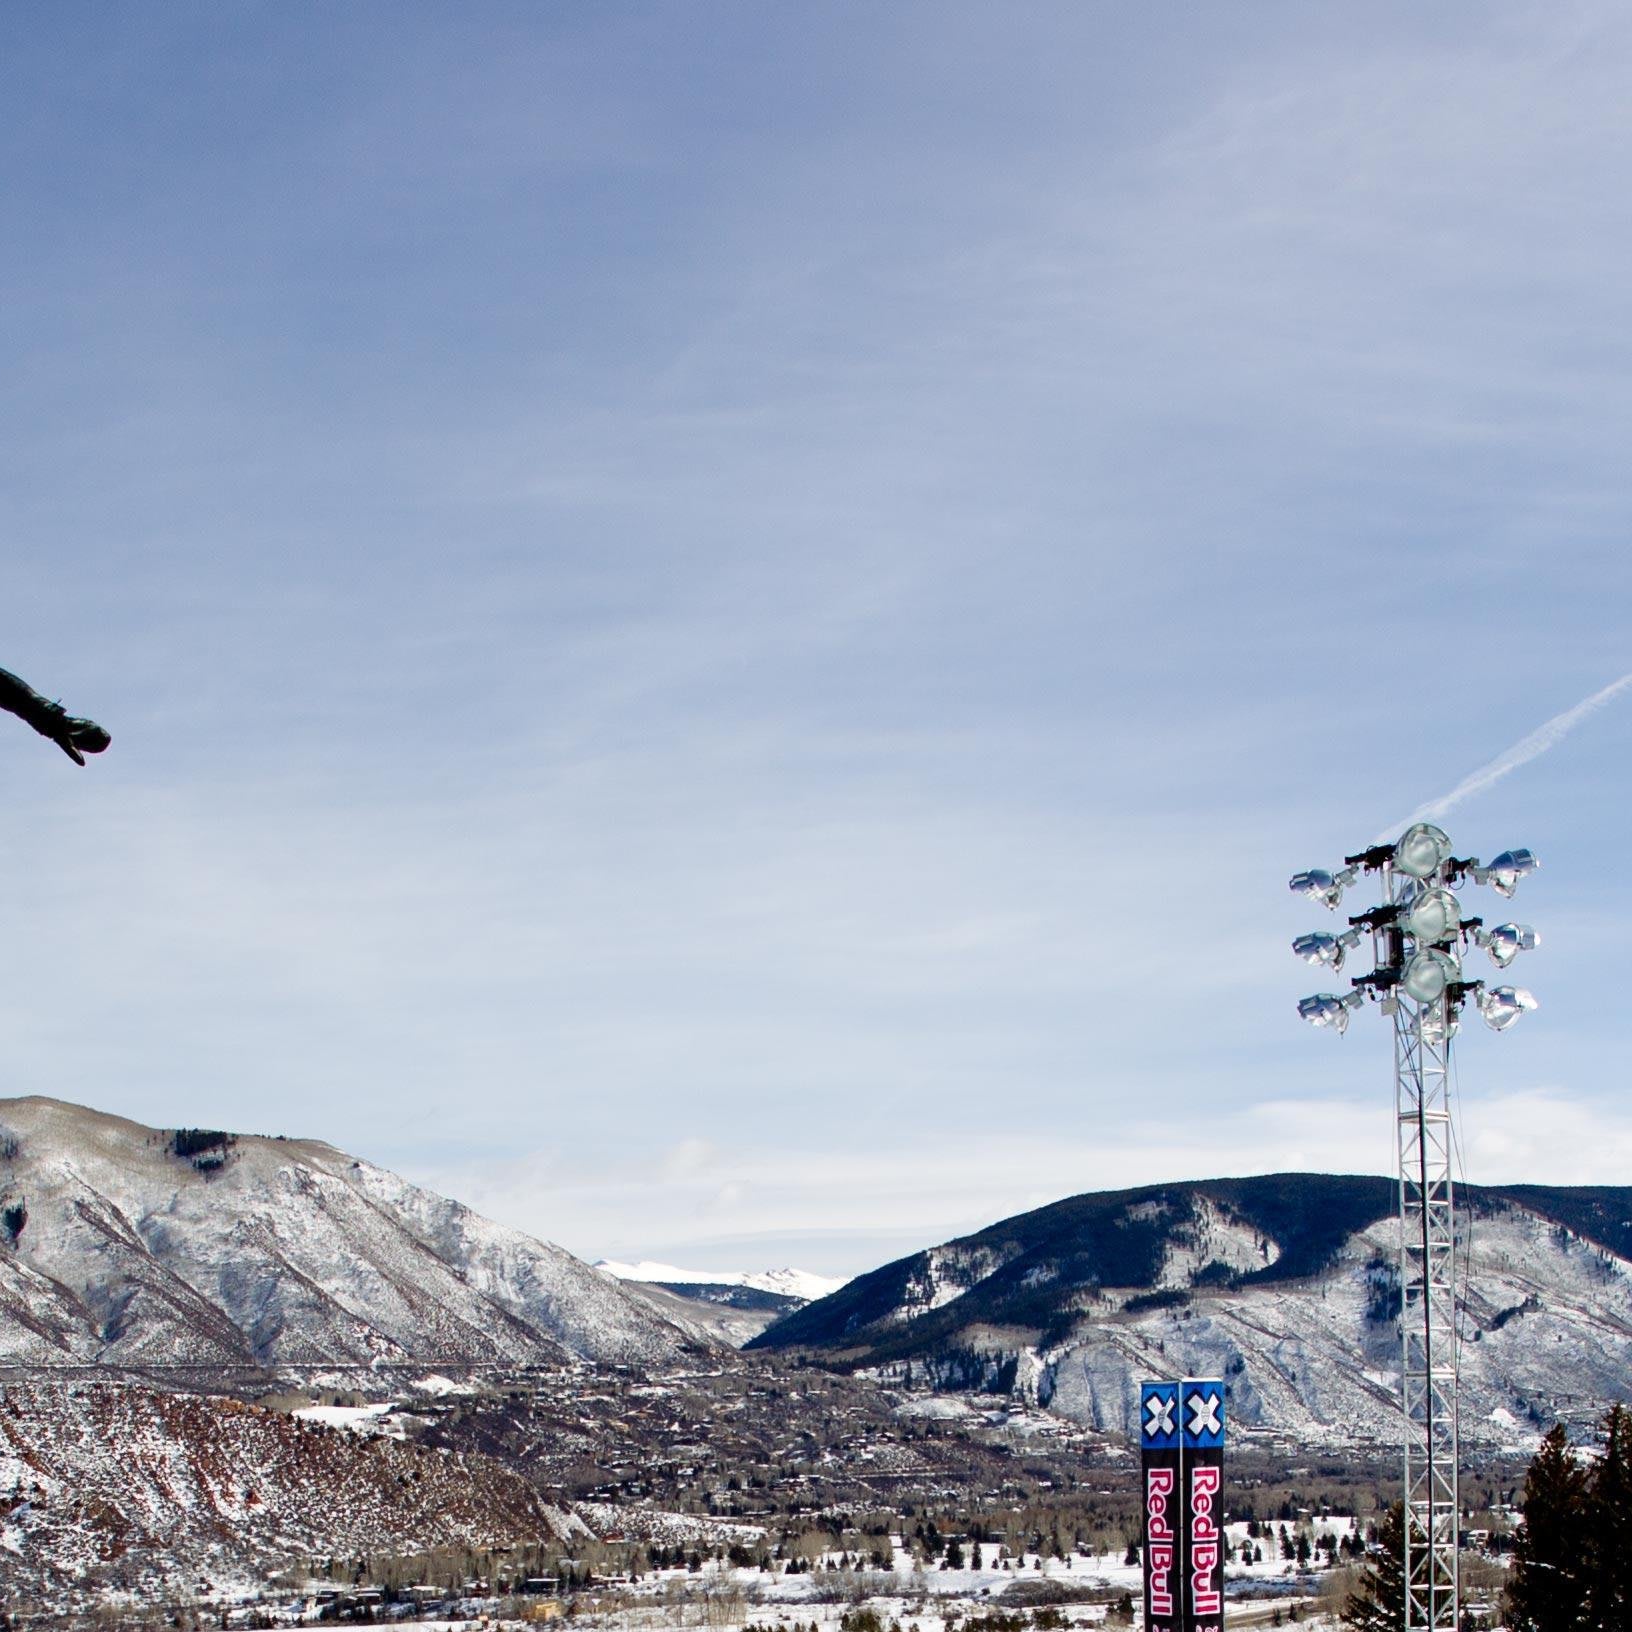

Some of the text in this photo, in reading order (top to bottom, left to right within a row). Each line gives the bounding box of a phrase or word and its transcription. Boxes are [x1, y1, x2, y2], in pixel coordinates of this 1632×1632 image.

[1146, 1467, 1174, 1616] Red Bull
[1190, 1466, 1221, 1616] Red Bull
